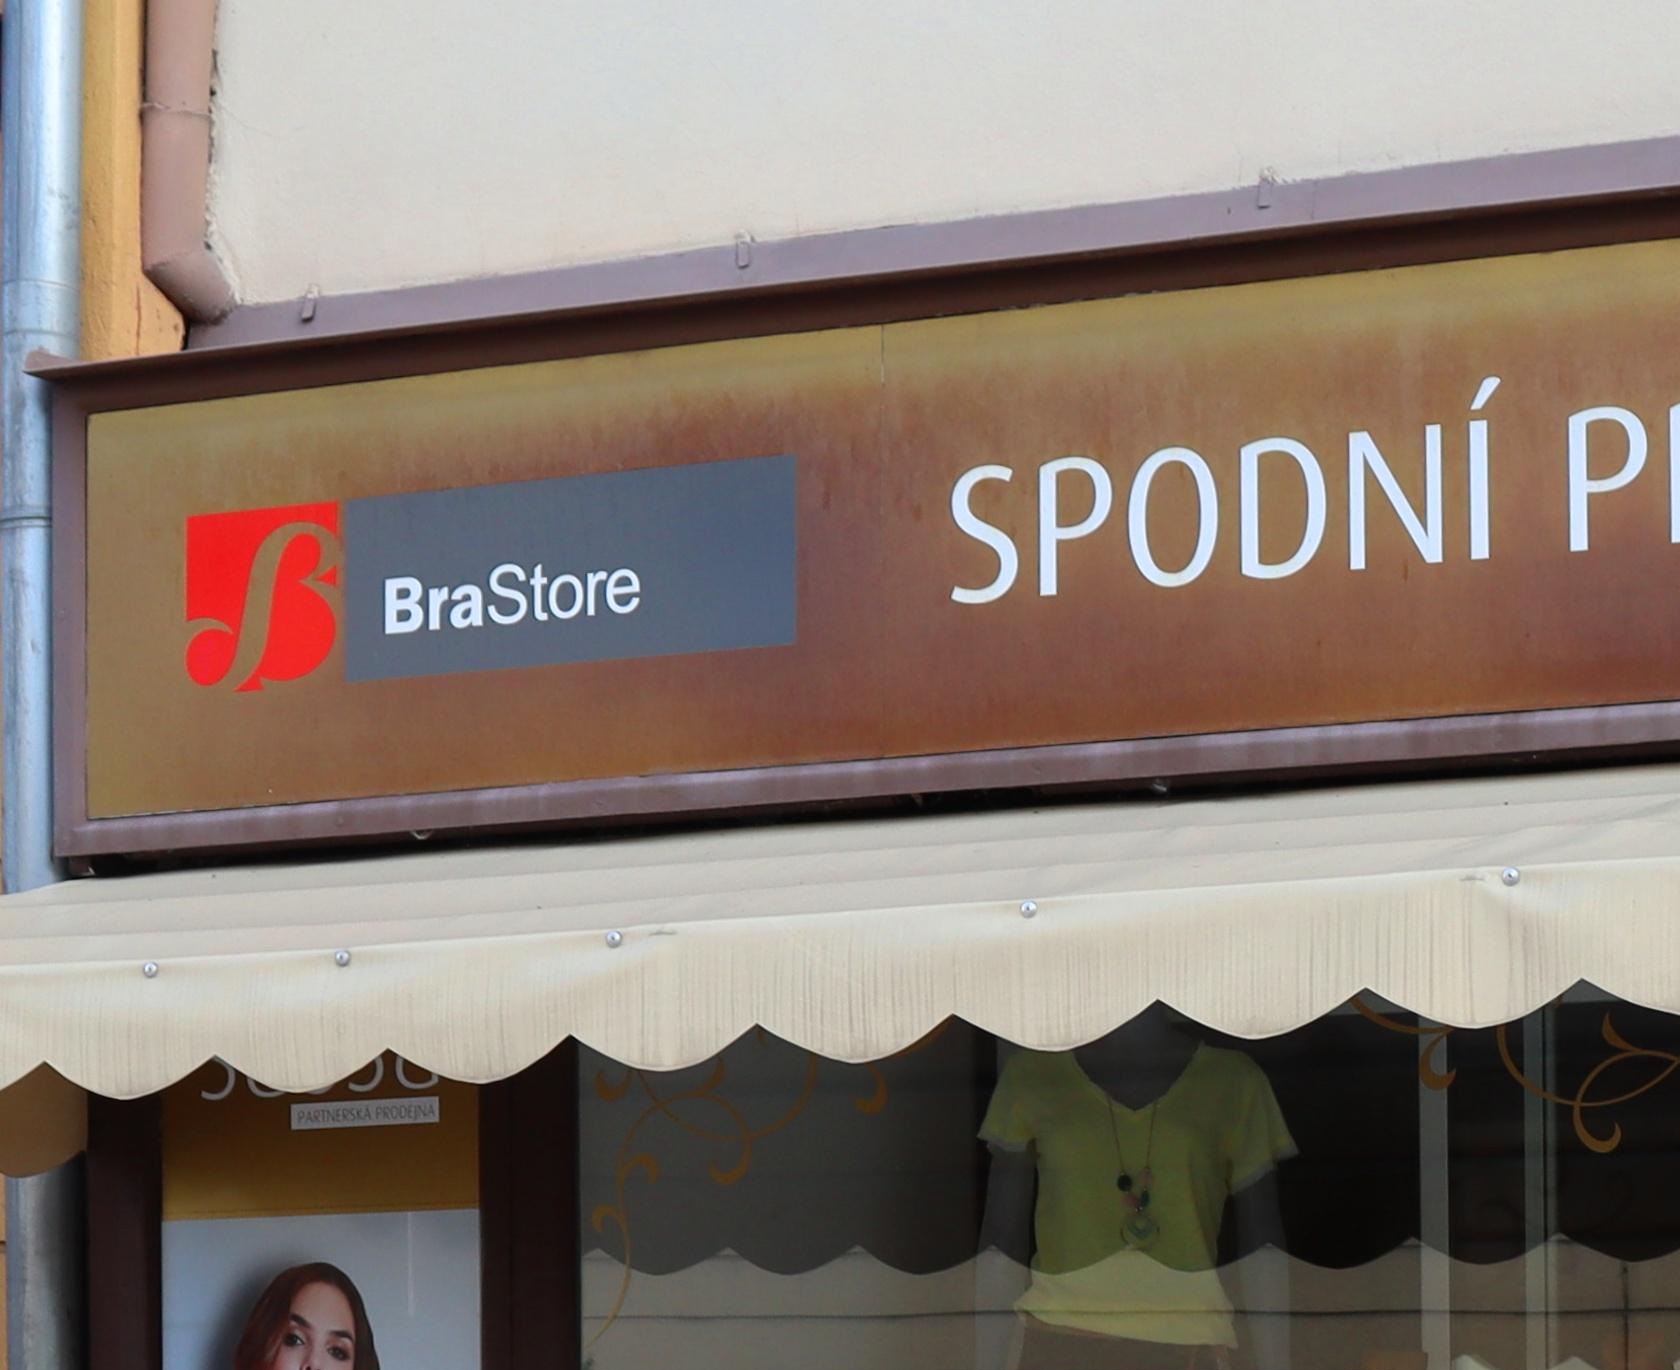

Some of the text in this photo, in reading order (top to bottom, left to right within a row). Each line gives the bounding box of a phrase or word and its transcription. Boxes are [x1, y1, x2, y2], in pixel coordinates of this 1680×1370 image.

[950, 376, 1501, 604] SPODNÍ
[383, 561, 642, 635] BraStore
[297, 1103, 436, 1124] PARTNERSKÁ PRODEJNA
